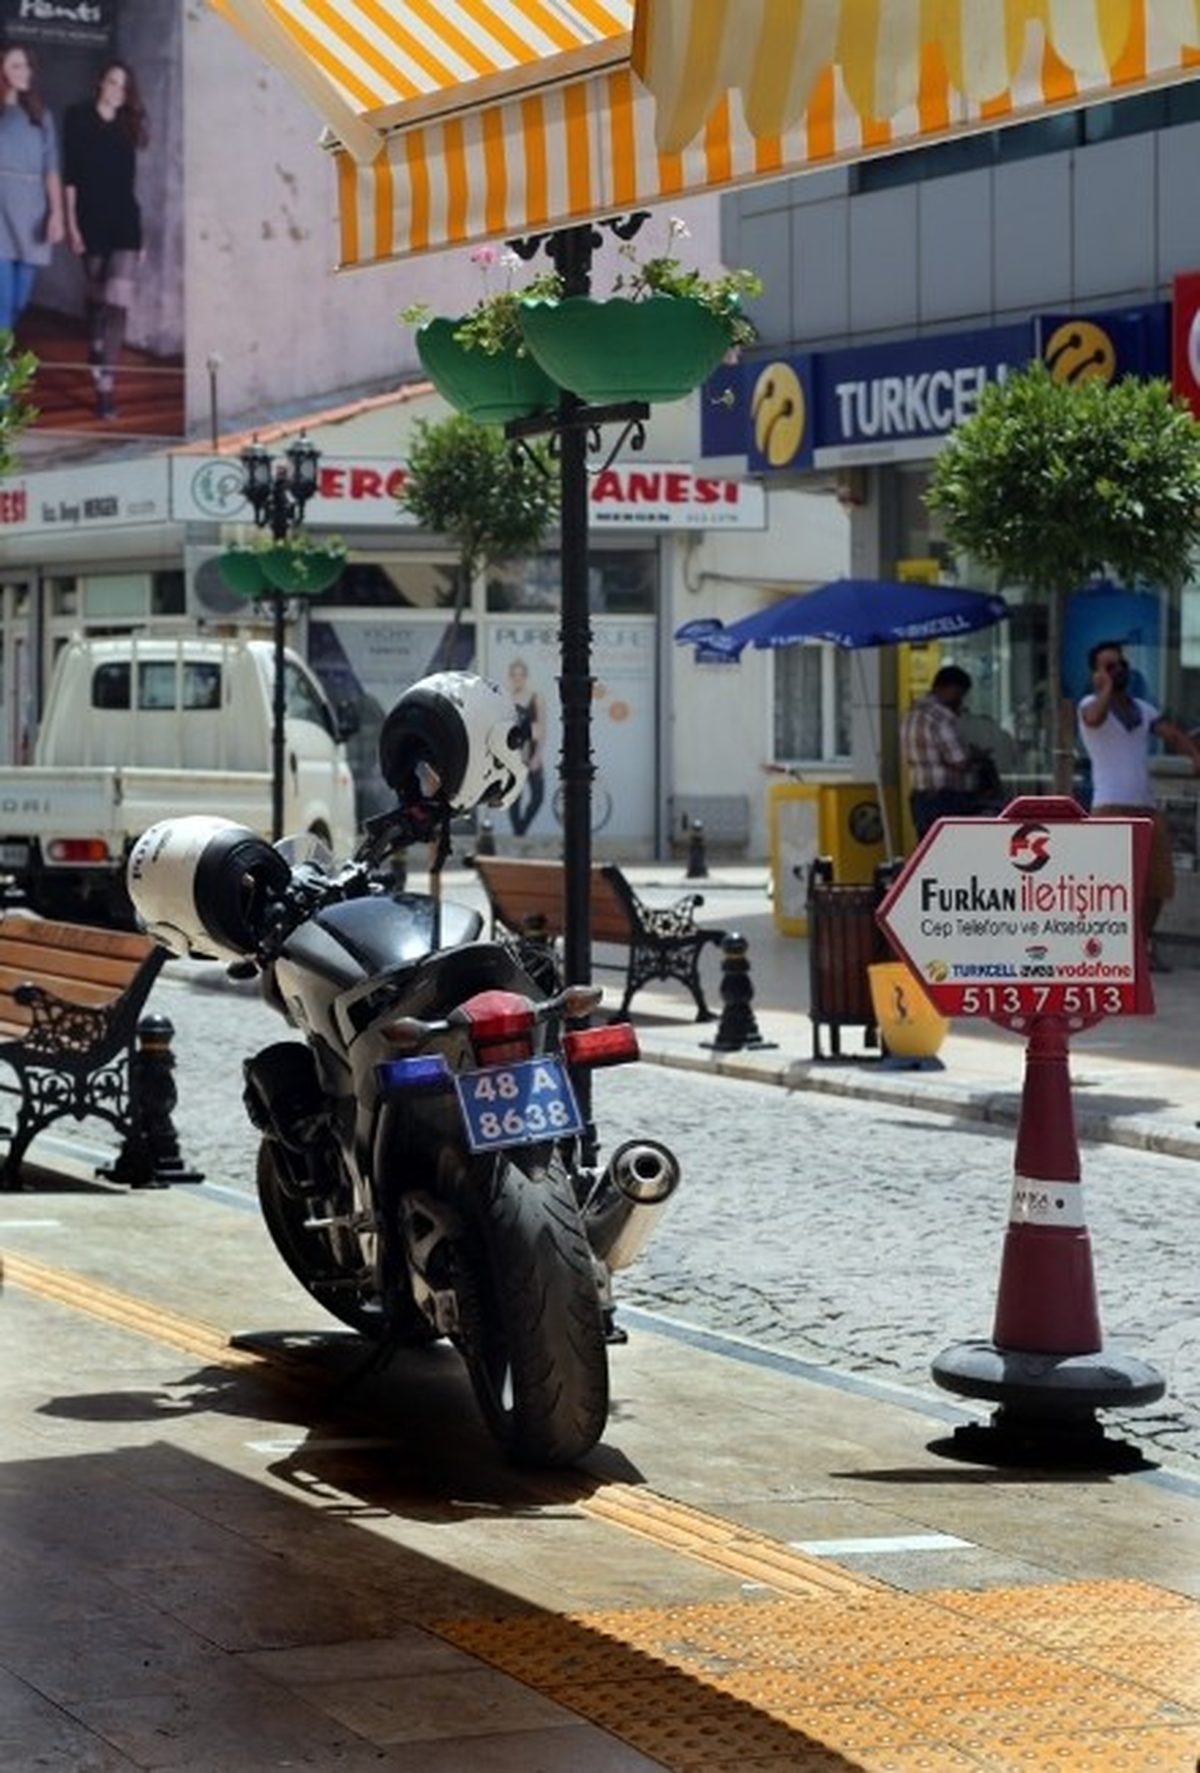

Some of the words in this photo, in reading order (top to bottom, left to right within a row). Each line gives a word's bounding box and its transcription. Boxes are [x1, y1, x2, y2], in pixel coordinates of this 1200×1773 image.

[921, 876, 1016, 911] FURKAN
[1021, 874, 1128, 919] iletişim
[921, 919, 952, 937] Cep
[957, 919, 1017, 936] Telefonu
[1021, 922, 1037, 936] ve
[952, 964, 1017, 978] TURKCELL
[1020, 965, 1054, 978] avea
[1056, 961, 1131, 978] vodafone
[962, 986, 1021, 1013] 513
[1033, 986, 1050, 1013] 7
[1063, 986, 1122, 1013] 513
[474, 1072, 520, 1102] 48
[532, 1067, 558, 1094] A
[480, 1100, 570, 1139] 8638
